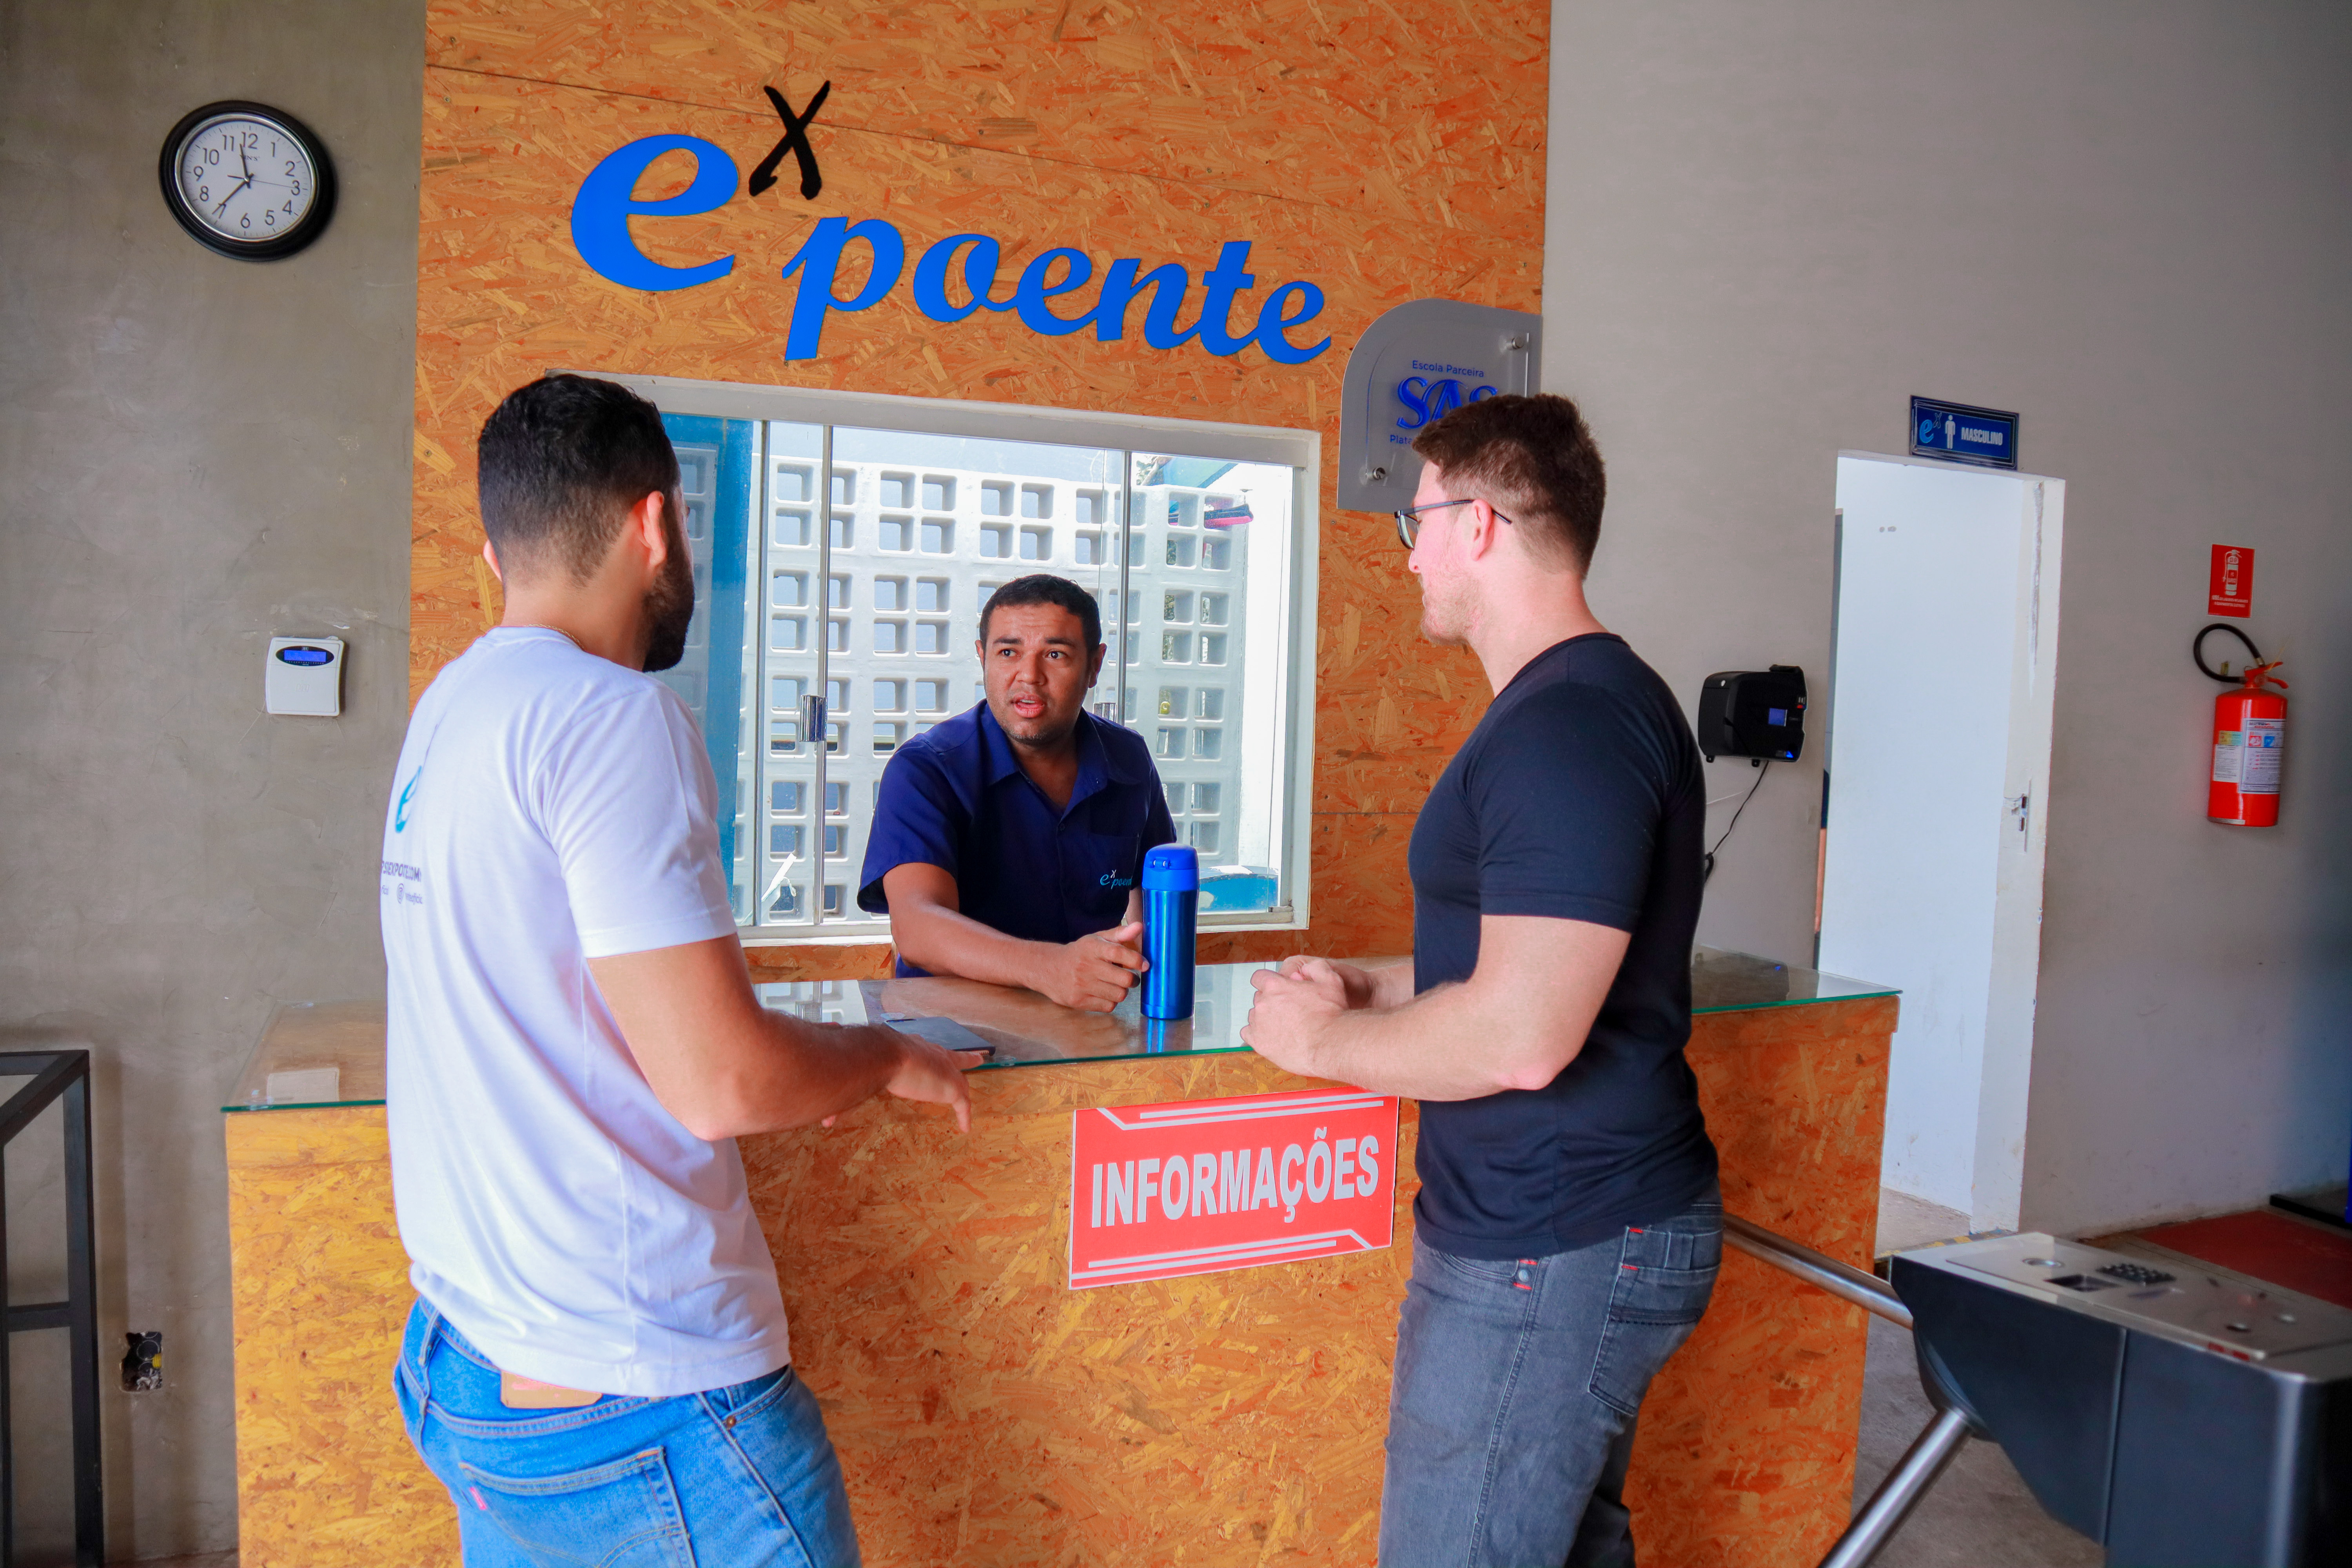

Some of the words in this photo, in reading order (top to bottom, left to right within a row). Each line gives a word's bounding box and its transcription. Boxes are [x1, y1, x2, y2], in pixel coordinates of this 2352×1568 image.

[221, 134, 234, 151] 11
[241, 131, 259, 149] 12
[202, 147, 220, 165] 10
[270, 141, 276, 158] 1
[193, 165, 204, 181] 9
[285, 160, 295, 177] 2
[199, 186, 209, 202] 8
[290, 180, 300, 196] 3
[282, 200, 292, 215] 4
[240, 213, 251, 229] 6
[265, 210, 275, 226] 5
[1412, 360, 1443, 372] Escola
[1446, 365, 1484, 377] Parceira
[1961, 426, 2003, 446] MASCULINO
[1091, 1126, 1380, 1229] INFORMAÇÕES
